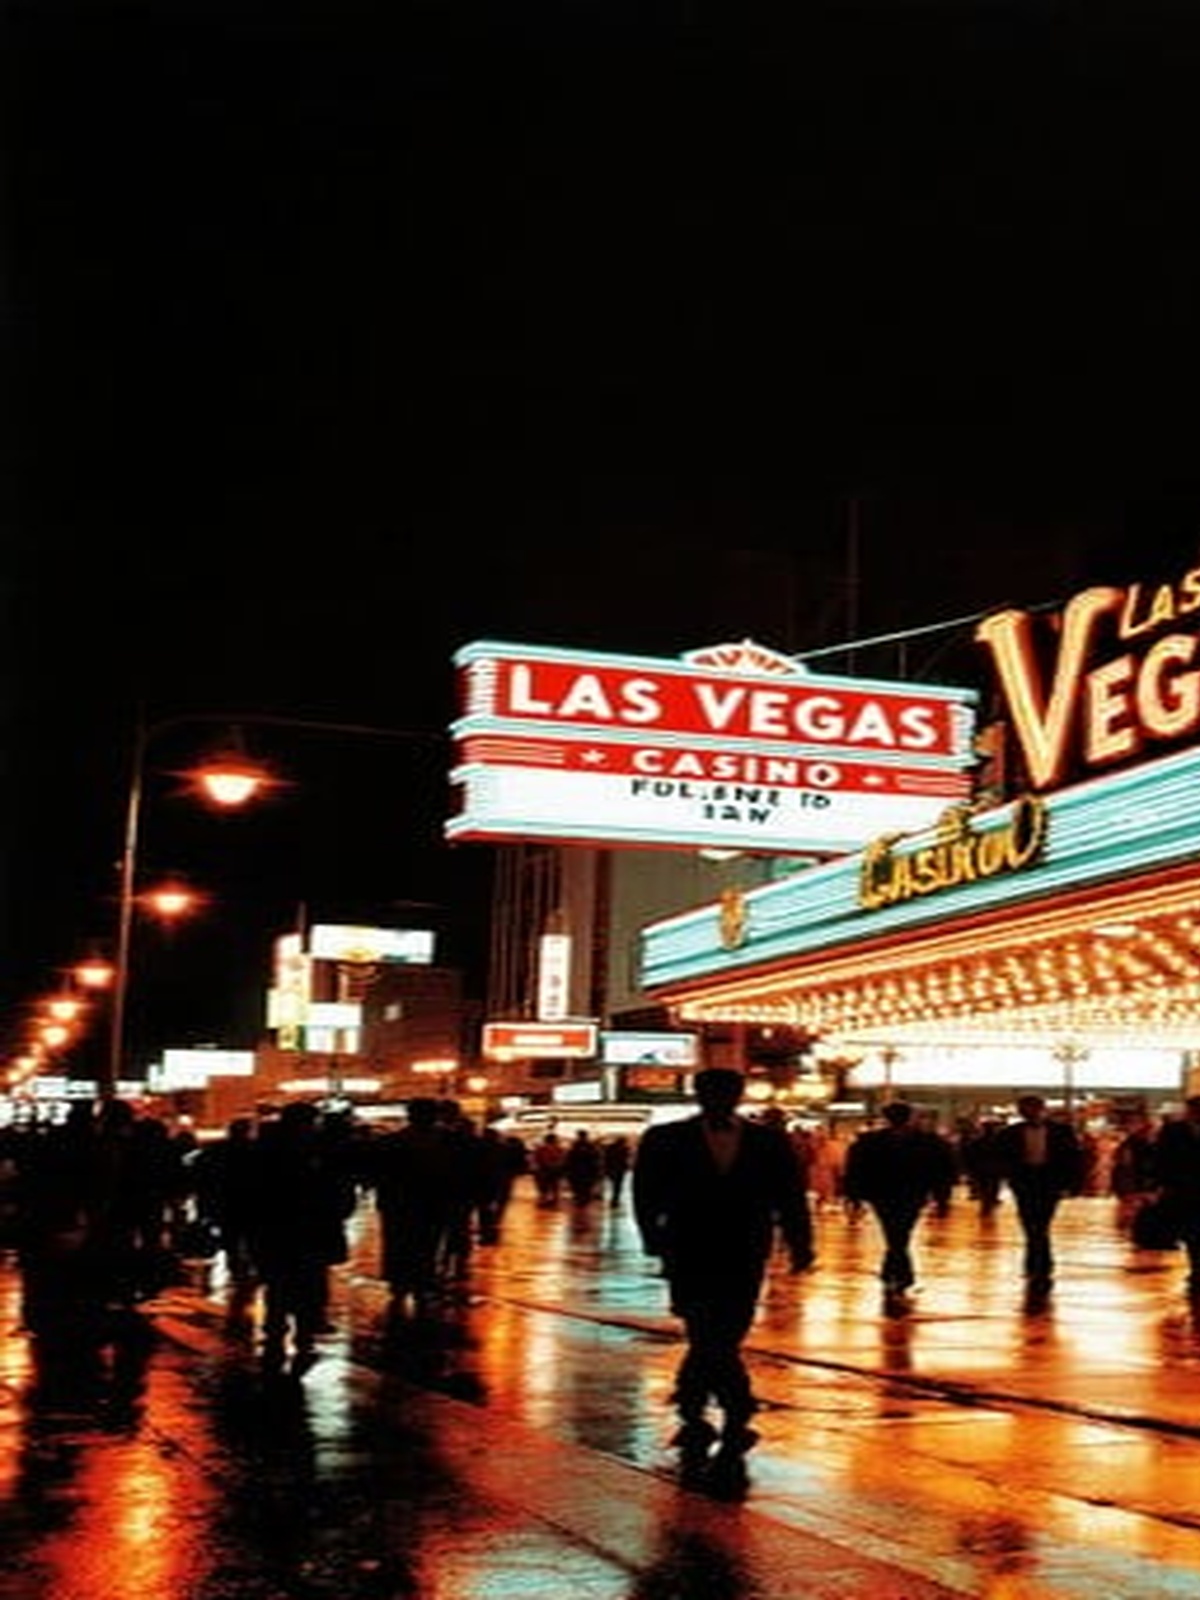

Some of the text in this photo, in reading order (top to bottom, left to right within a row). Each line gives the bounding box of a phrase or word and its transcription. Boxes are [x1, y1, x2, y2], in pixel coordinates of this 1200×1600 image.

[509, 664, 938, 748] LAS VEGAS
[633, 748, 841, 786] CASINO
